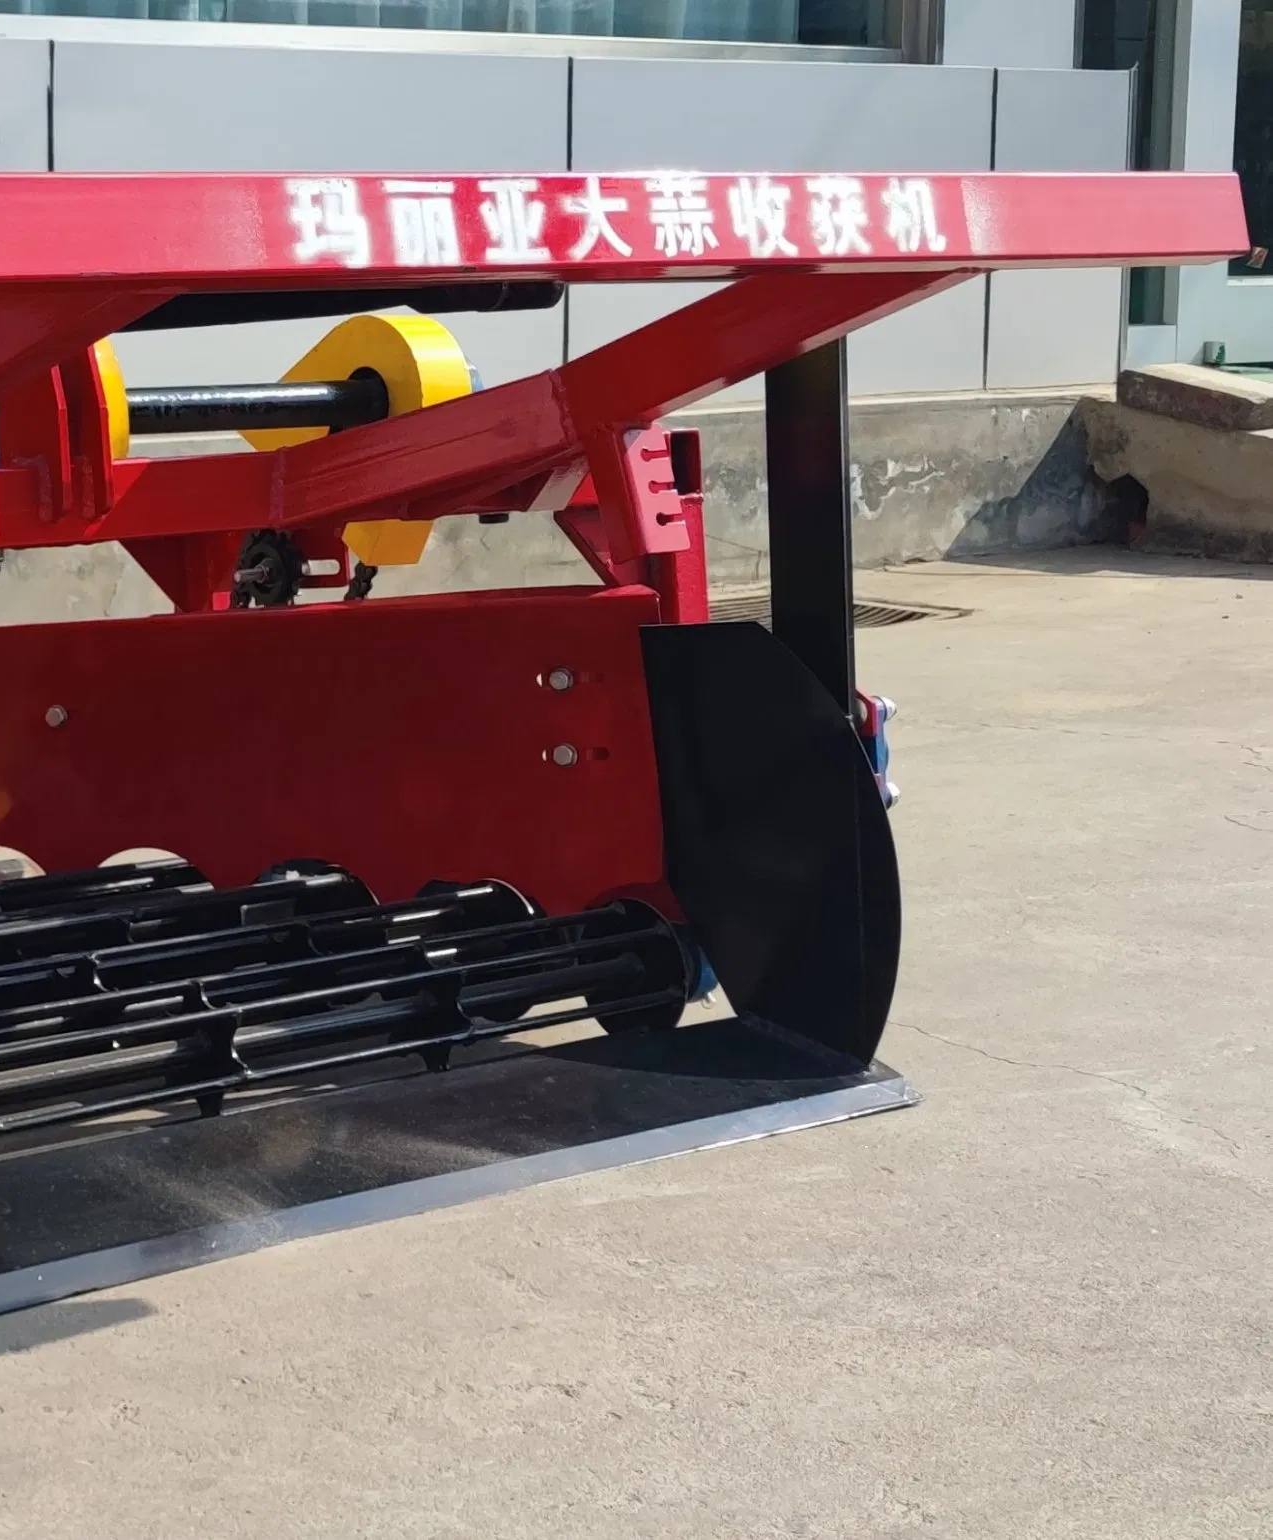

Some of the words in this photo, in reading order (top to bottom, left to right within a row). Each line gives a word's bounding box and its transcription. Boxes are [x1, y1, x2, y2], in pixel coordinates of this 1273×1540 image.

[287, 173, 946, 267] 玛丽亚大蒜收获机
